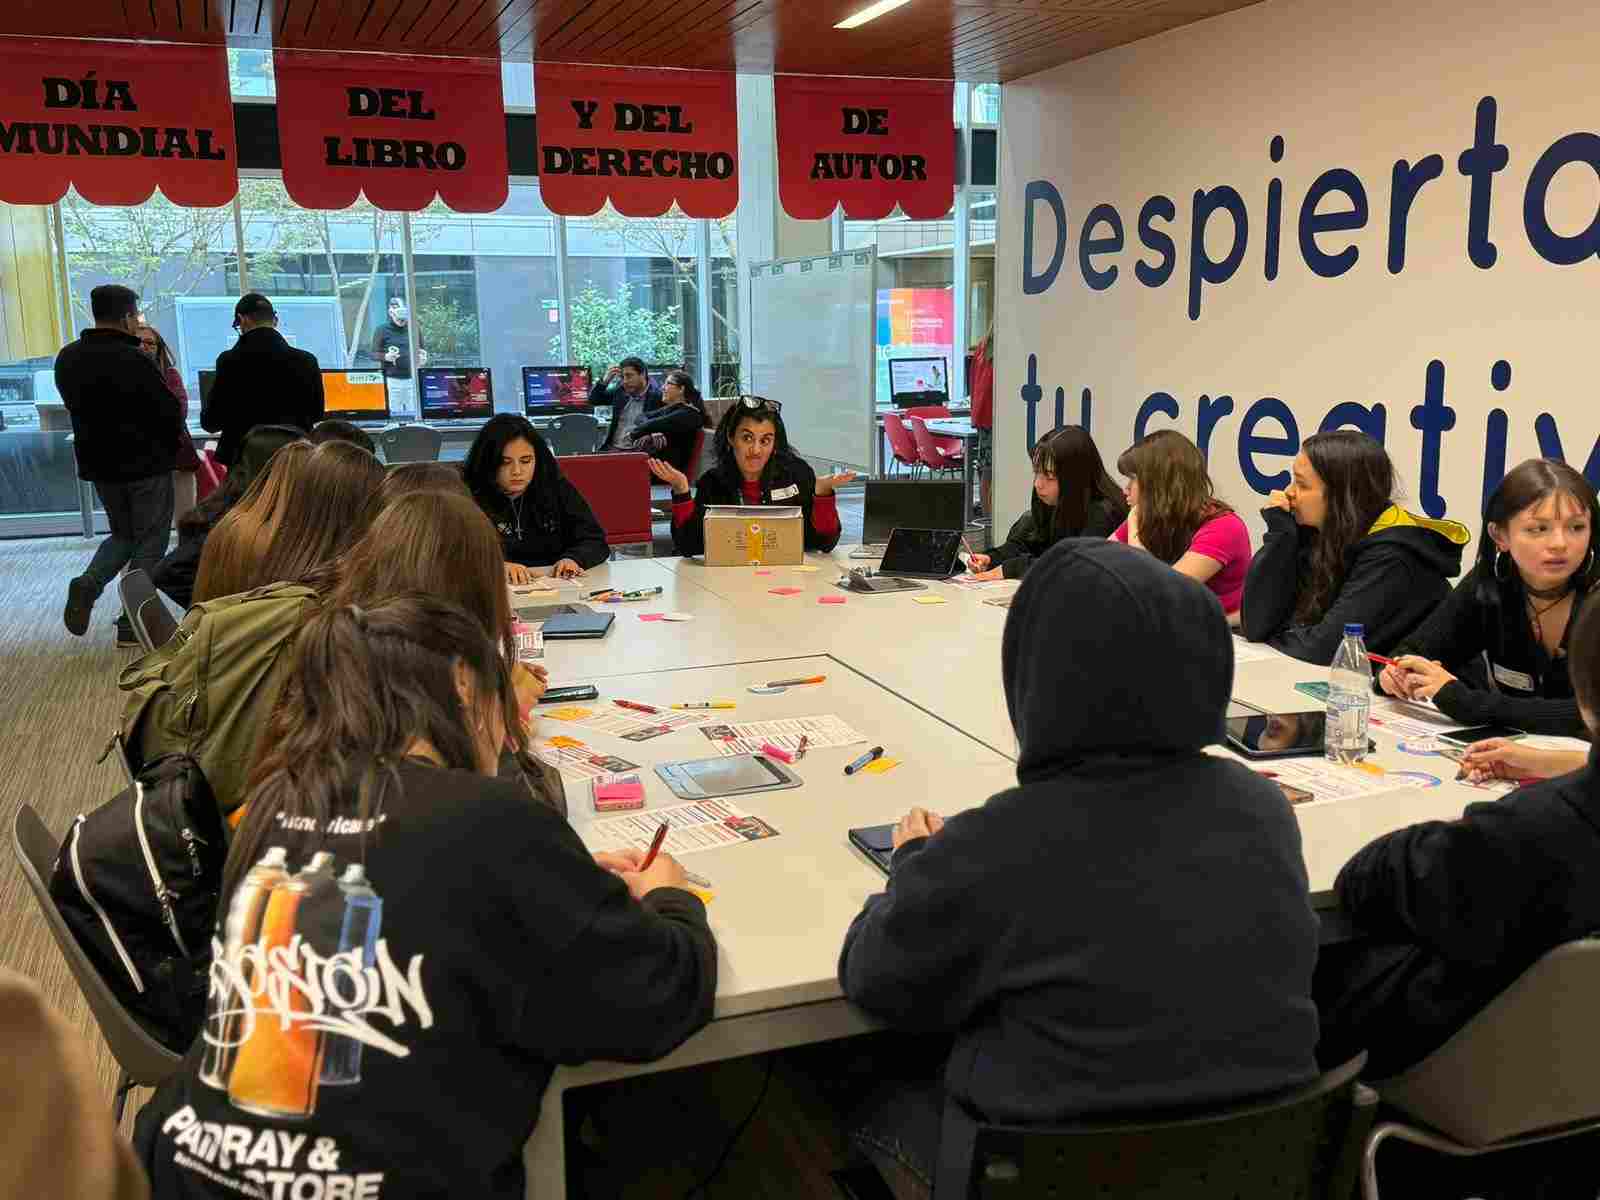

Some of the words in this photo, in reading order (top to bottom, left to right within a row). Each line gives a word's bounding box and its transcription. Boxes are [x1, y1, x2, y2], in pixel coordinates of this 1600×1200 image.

[42, 70, 138, 112] DÍA
[346, 86, 437, 121] DEL
[571, 100, 598, 129] Y
[614, 102, 693, 134] DEL
[841, 107, 889, 136] DE
[0, 121, 225, 161] MUNDIAL
[324, 136, 466, 171] LIBRO
[543, 146, 734, 180] DERECHO
[810, 152, 927, 181] AUTOR
